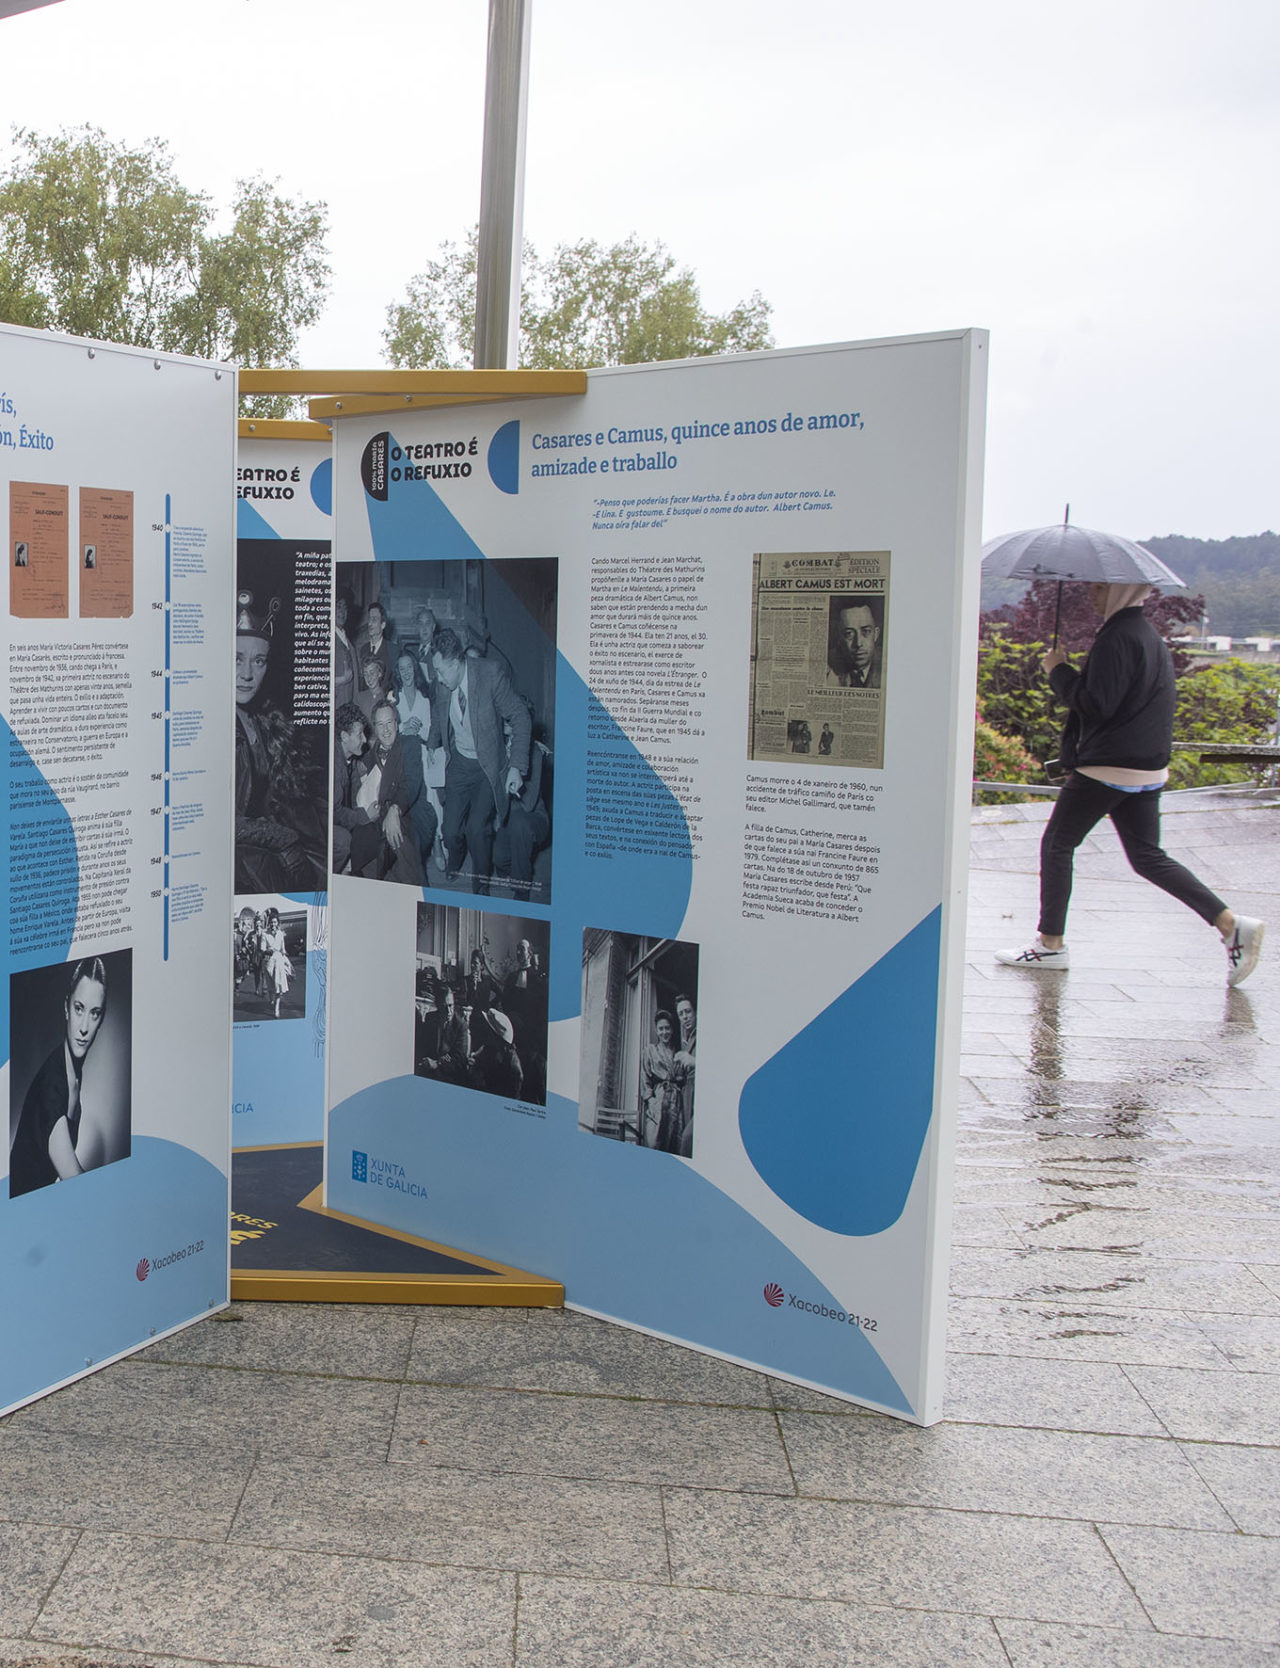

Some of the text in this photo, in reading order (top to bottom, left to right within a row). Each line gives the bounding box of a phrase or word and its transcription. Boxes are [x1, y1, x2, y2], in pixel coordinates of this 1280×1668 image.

[19, 424, 54, 450] Éxito
[532, 412, 864, 450] Casares e Camus, quince anos de amor,
[391, 436, 478, 461] O TEATRO É
[377, 440, 385, 490] CASARES
[391, 462, 472, 482] O REFUXIO
[532, 451, 677, 477] amizade e traballo
[290, 466, 300, 482] É
[622, 500, 635, 508] que
[636, 496, 668, 507] poderías
[670, 495, 689, 506] facer
[691, 493, 722, 503] Martha.
[724, 490, 730, 502] É
[737, 492, 755, 501] obra
[757, 491, 772, 500] dun
[799, 490, 821, 498] novo.
[626, 509, 664, 519] gustoume.
[666, 508, 671, 516] E
[672, 506, 702, 516] busquei
[733, 505, 743, 513] do
[744, 505, 769, 513] autor.
[773, 502, 801, 511] Albert
[803, 502, 833, 511] Camus.
[592, 522, 614, 530] Nunca
[630, 520, 650, 530] falar
[592, 557, 609, 565] Cando
[631, 556, 655, 564] Herrand
[791, 559, 834, 567] COMBAT
[759, 579, 886, 588] ALBERT CAMUS EST MORT
[746, 775, 768, 783] Camus
[796, 778, 801, 786] 4
[812, 780, 838, 788] xaneiro
[839, 781, 848, 789] de
[849, 782, 868, 792] 1960,
[746, 785, 776, 794] accidente
[778, 787, 786, 795] de
[787, 788, 809, 797] tráfico
[811, 790, 835, 799] camiño
[837, 791, 845, 799] de
[847, 792, 864, 801] París
[745, 804, 766, 813] falece.
[758, 796, 778, 804] editor
[779, 797, 800, 806] Michel
[853, 803, 875, 812] tamén
[371, 1158, 405, 1178] XUNTA
[370, 1172, 428, 1199] DE GALICIA
[152, 1249, 186, 1272] Xacobeo
[788, 1293, 846, 1322] Xacobeo
